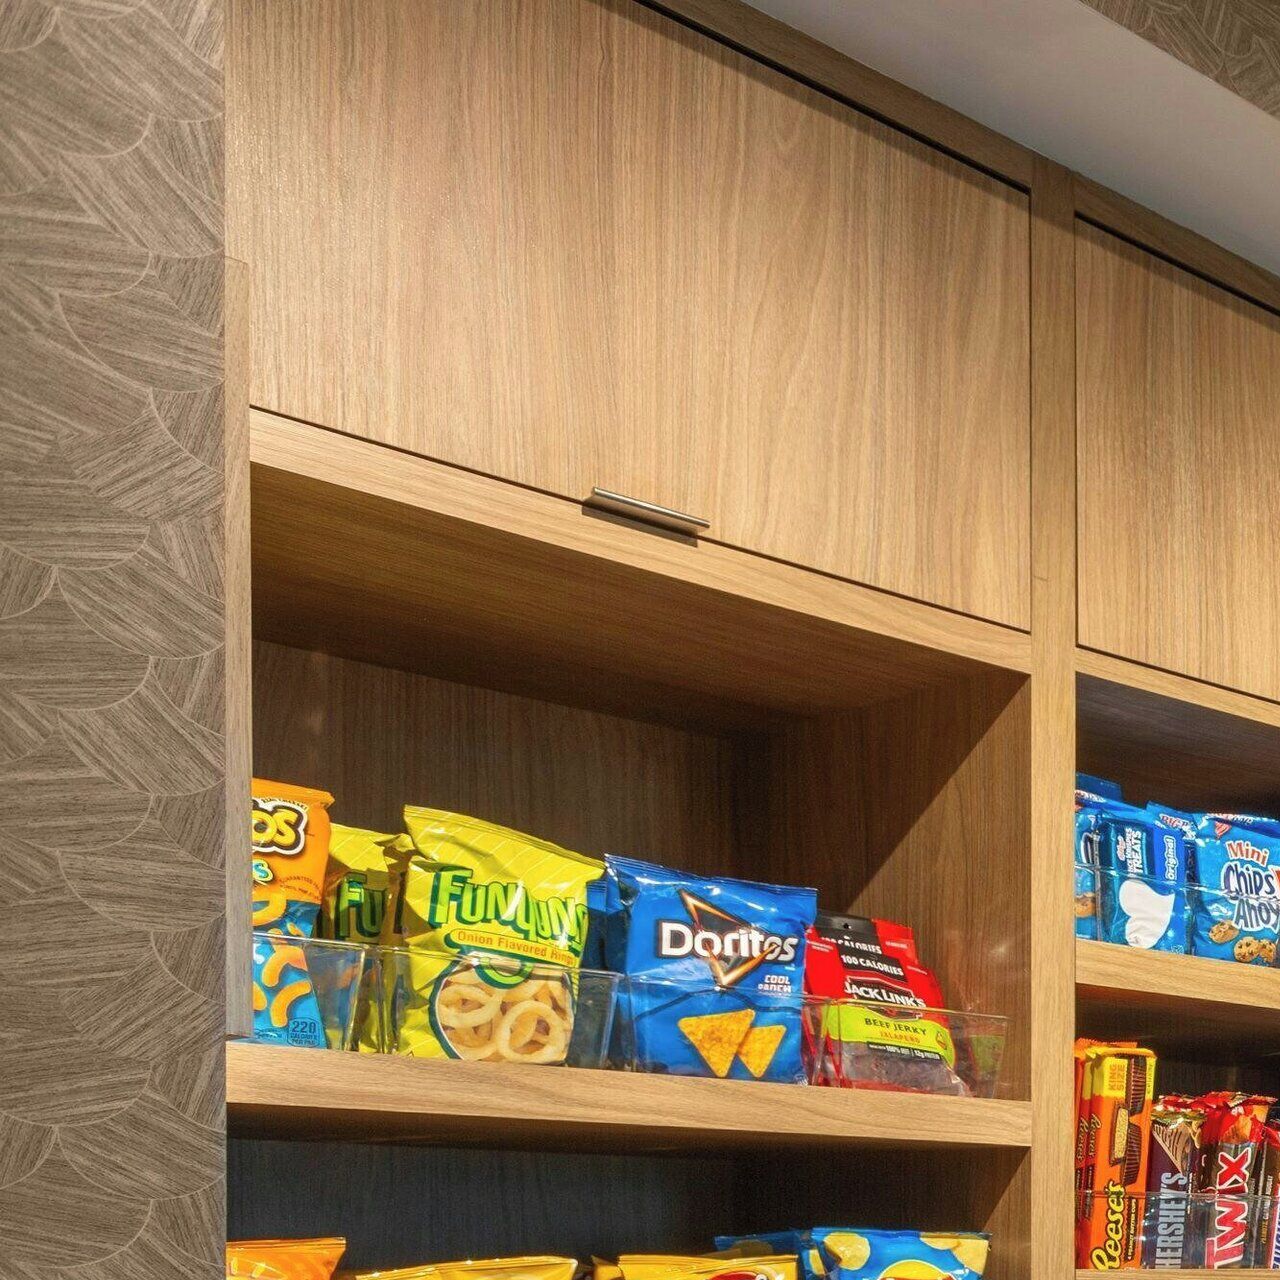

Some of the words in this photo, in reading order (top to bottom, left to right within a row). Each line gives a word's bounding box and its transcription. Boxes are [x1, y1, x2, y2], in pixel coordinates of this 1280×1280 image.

[1164, 835, 1177, 884] Original
[1226, 840, 1269, 866] Mini
[1222, 862, 1276, 899] Chips
[457, 931, 493, 946] Onion
[498, 937, 547, 957] Flavored
[661, 922, 799, 961] Doritos
[841, 954, 858, 966] 100
[859, 957, 904, 976] CALORIES
[764, 974, 790, 985] COOL
[844, 981, 880, 1000] JACK
[883, 990, 926, 1008] LINK'S
[864, 1018, 890, 1029] BEEF
[894, 1022, 927, 1035] JERKY
[1108, 1063, 1117, 1091] KING
[1117, 1064, 1126, 1091] SIZE
[1156, 1172, 1188, 1269] HERSHEY'S
